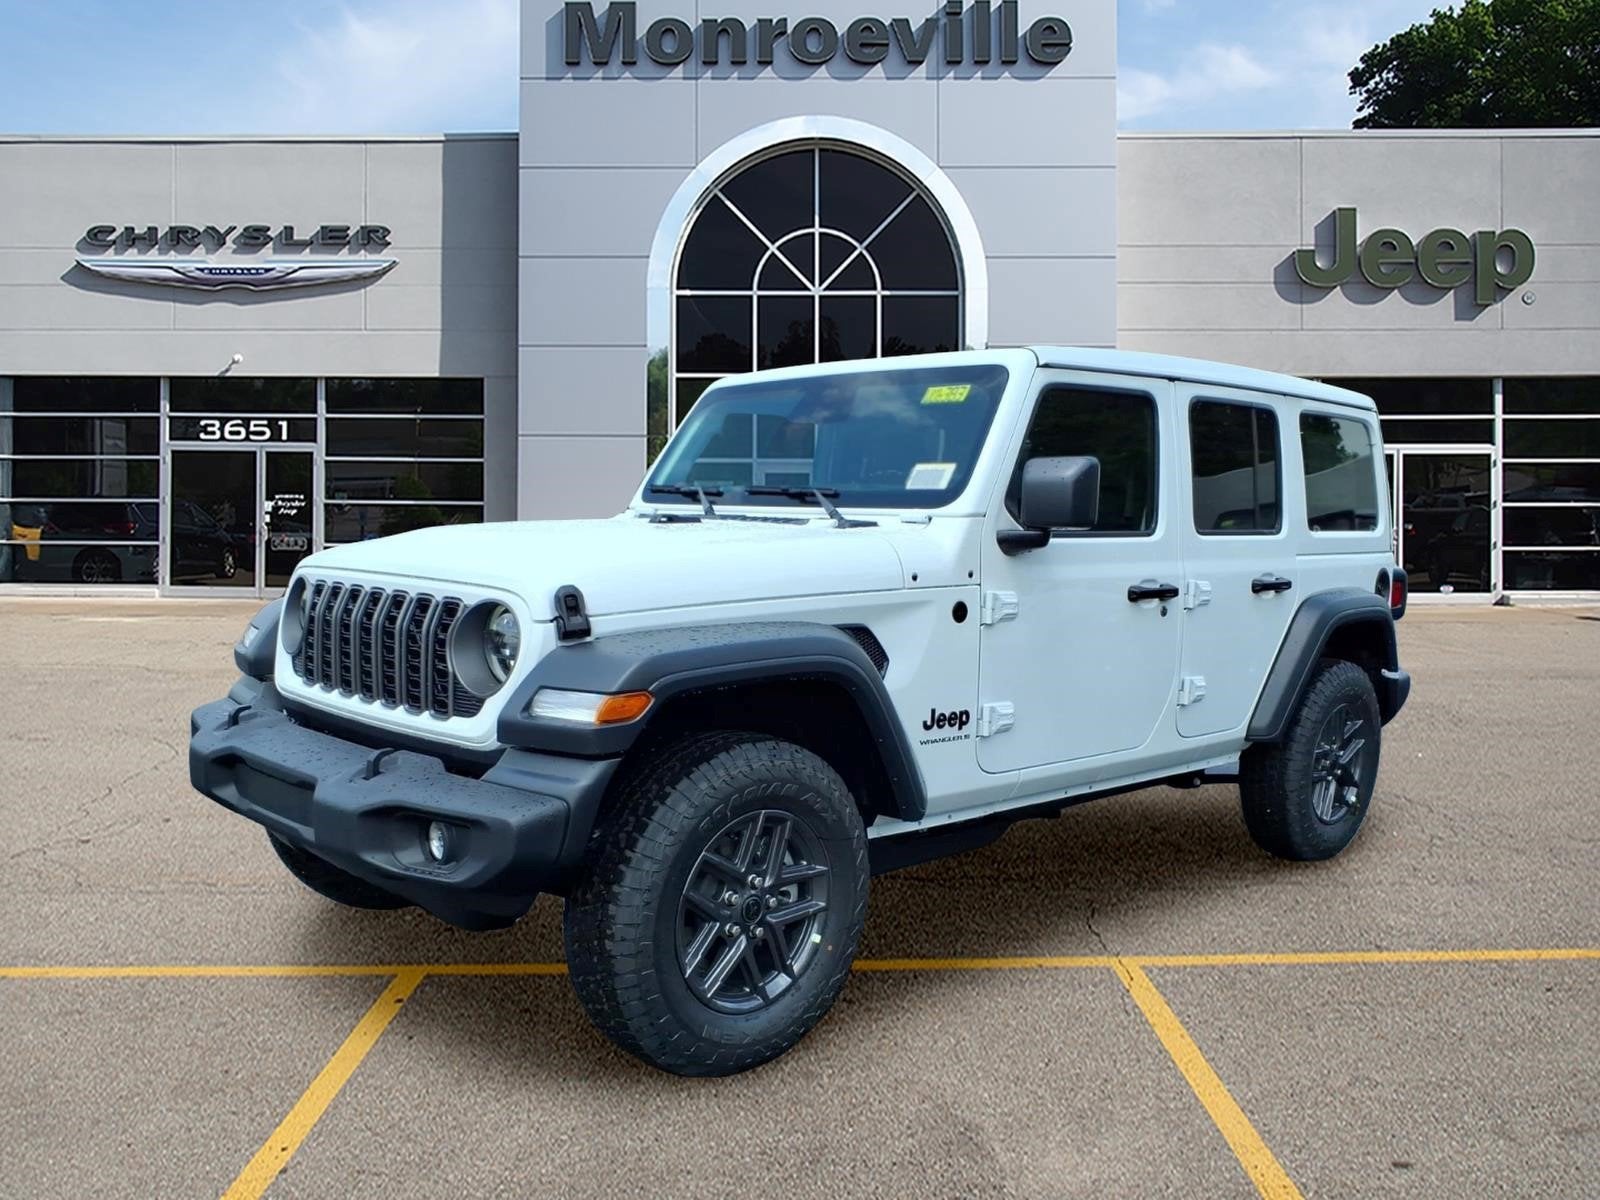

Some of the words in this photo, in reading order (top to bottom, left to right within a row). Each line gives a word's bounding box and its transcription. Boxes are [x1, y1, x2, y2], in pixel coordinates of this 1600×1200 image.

[564, 1, 1073, 64] Monroeville
[86, 225, 392, 247] CHRYSLER
[1294, 207, 1536, 305] Jeep
[199, 419, 288, 441] 3651
[922, 708, 970, 731] Jeep
[919, 735, 963, 746] WRANGLER
